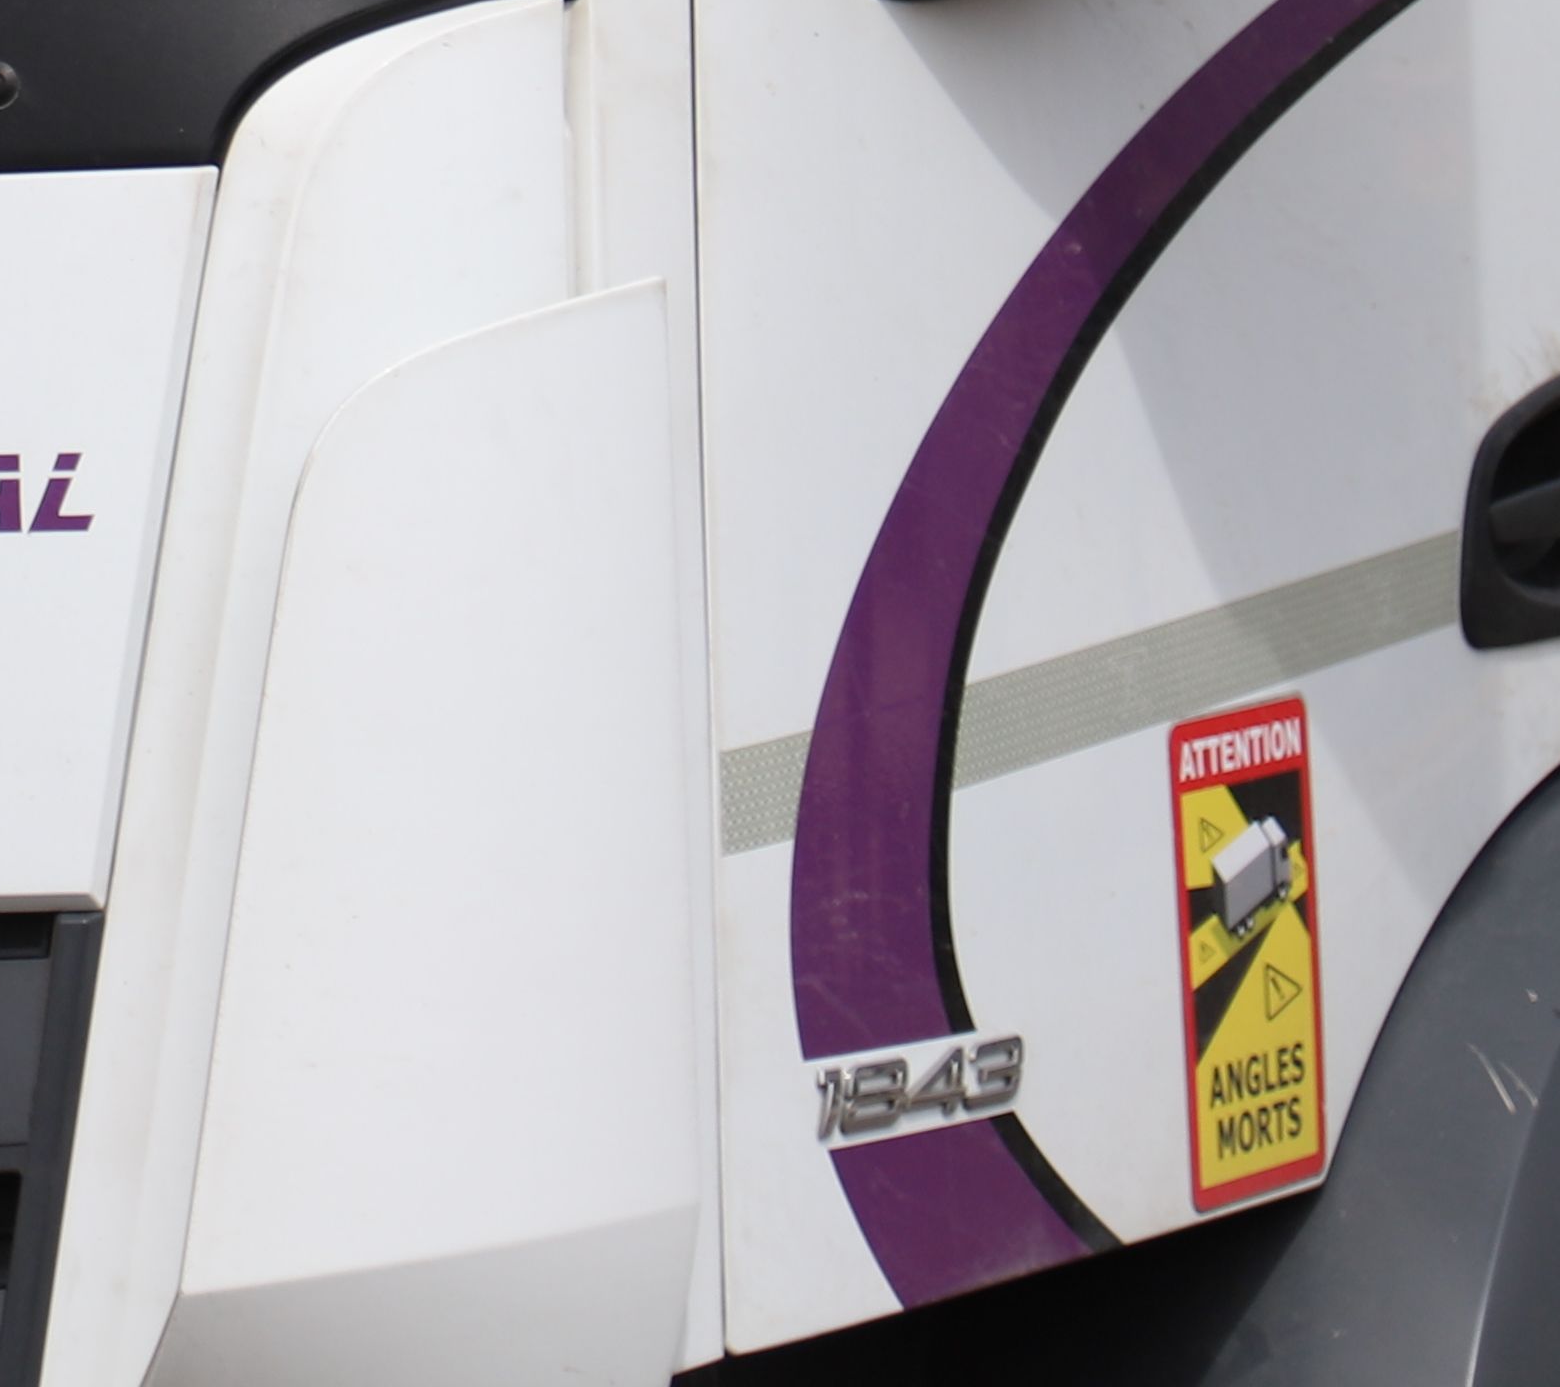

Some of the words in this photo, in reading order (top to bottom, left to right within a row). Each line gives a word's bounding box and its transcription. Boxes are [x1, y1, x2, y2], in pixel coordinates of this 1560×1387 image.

[1179, 718, 1302, 783] ATTENTION
[816, 1034, 1025, 1148] 1843
[1209, 1042, 1305, 1107] ANGLES
[1216, 1106, 1303, 1160] MORTS
